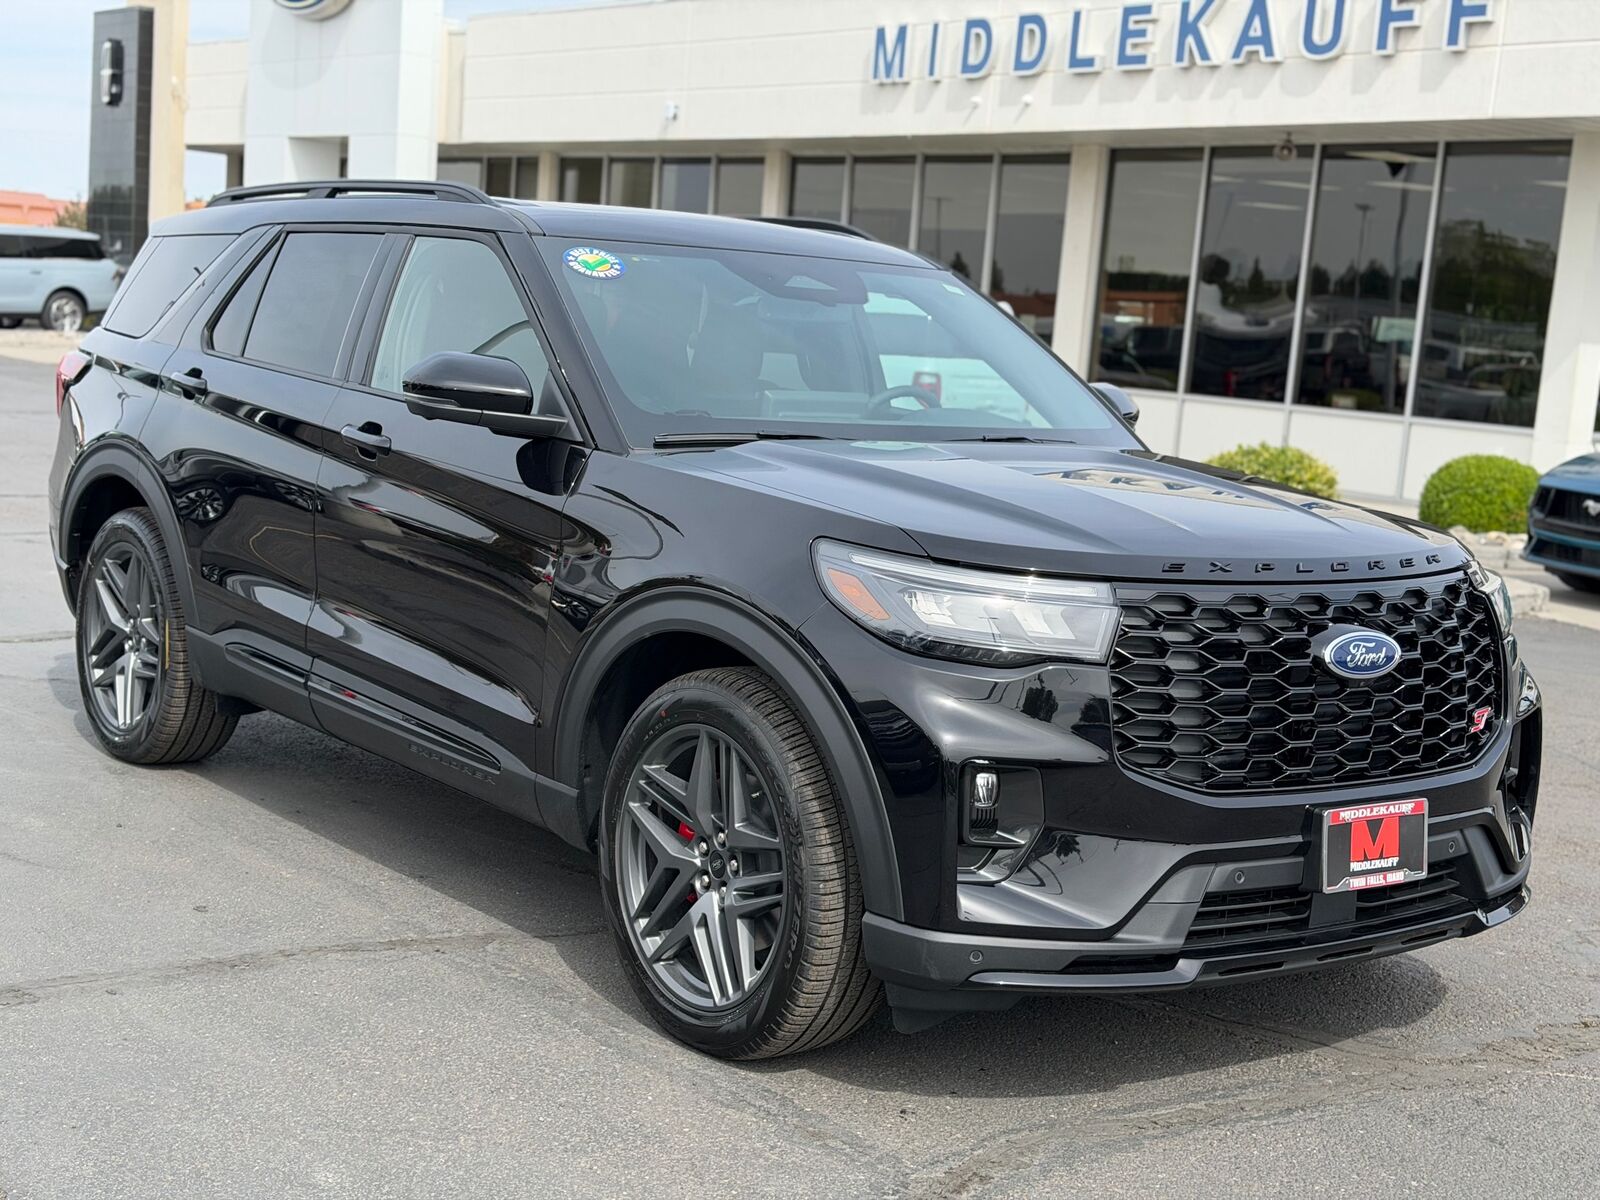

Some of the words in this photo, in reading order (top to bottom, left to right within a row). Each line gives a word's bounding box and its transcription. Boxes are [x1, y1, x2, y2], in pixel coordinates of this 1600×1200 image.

[872, 0, 1488, 82] MIDDLEKAUFF
[1162, 554, 1441, 573] EXPLORER
[1347, 641, 1387, 667] Ford
[1339, 803, 1416, 821] MIDDLEKAUFF
[1350, 816, 1400, 862] M
[1350, 857, 1400, 872] MIDDLEKAUFF
[1350, 877, 1366, 888] TWIN
[1386, 871, 1405, 884] IDAHO
